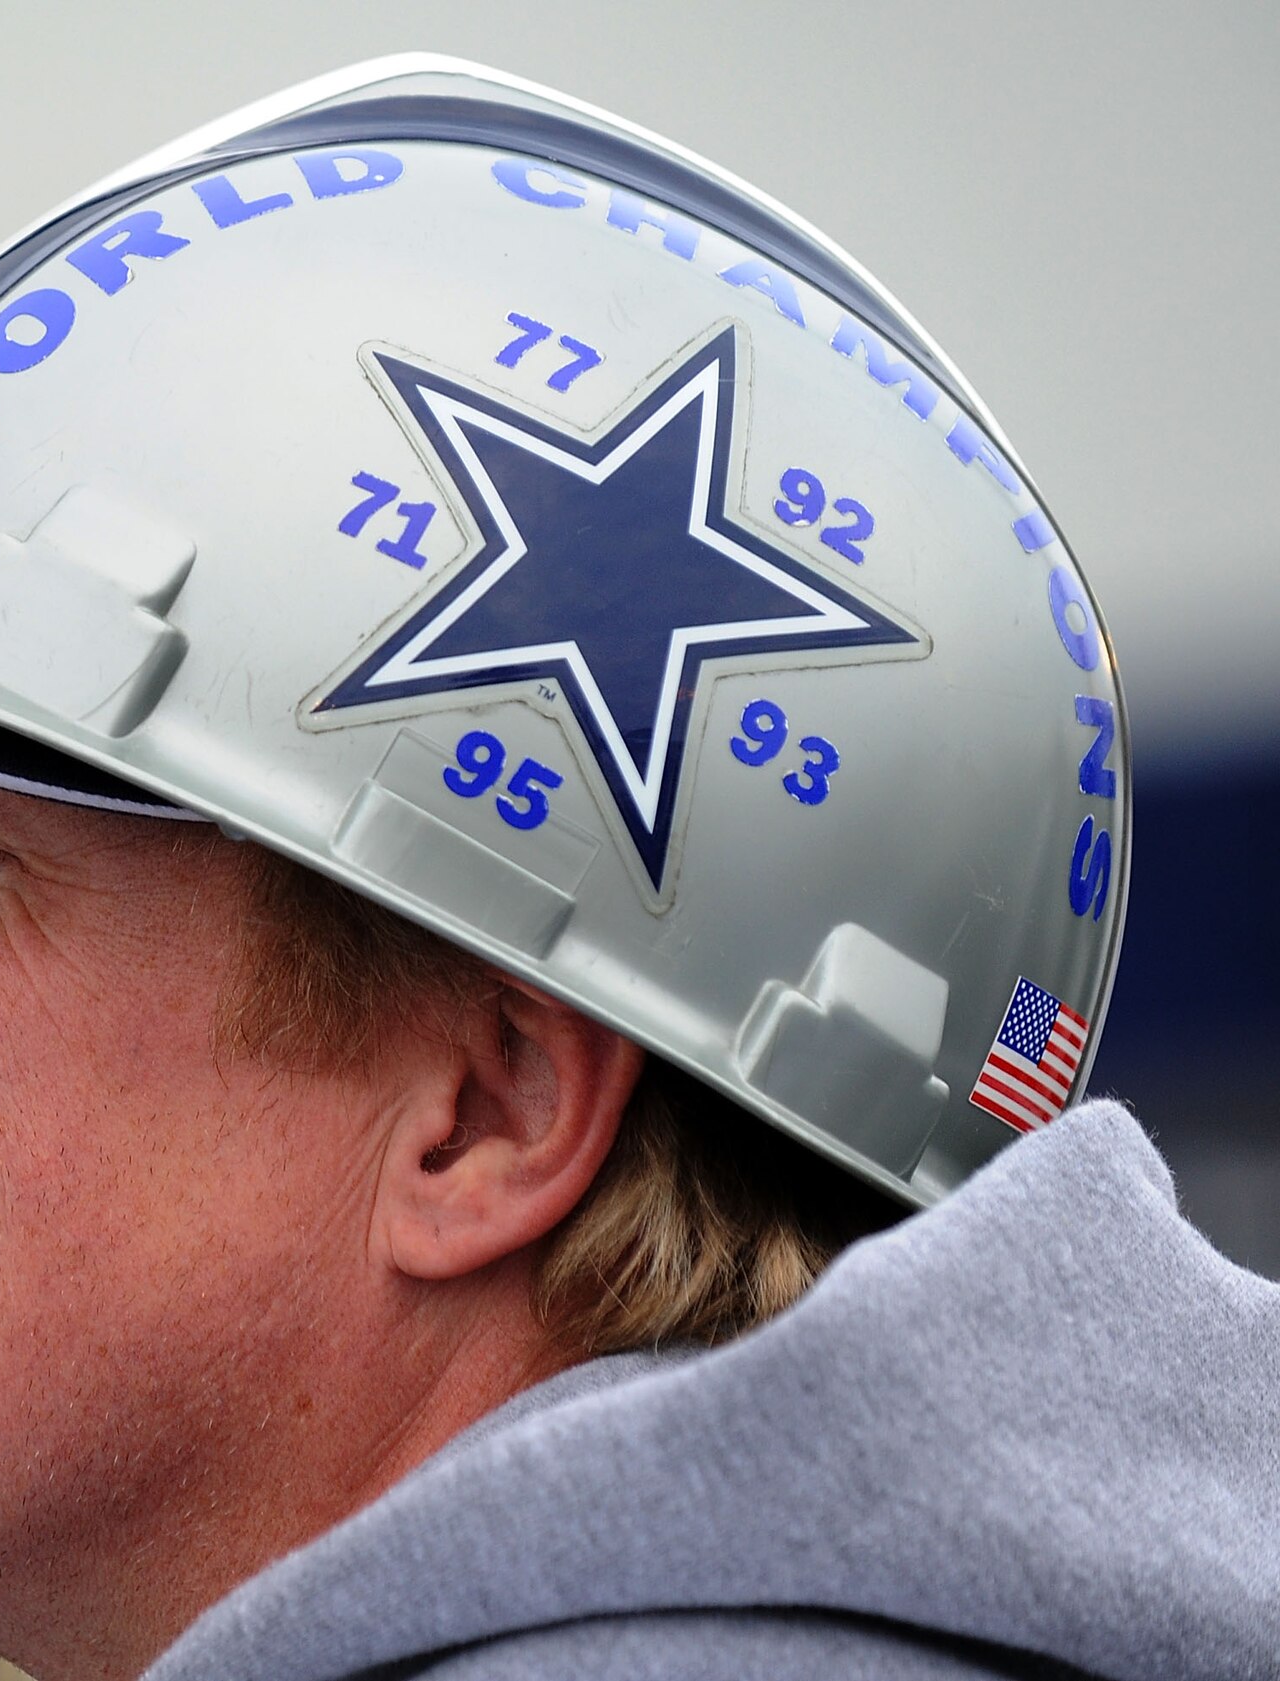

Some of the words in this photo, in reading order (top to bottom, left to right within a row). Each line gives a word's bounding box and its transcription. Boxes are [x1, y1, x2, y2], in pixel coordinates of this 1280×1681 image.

[494, 310, 605, 393] 77
[337, 470, 438, 571] 71
[490, 158, 1117, 922] CHAMPIONS
[773, 466, 875, 567] 92
[441, 729, 565, 832] 95
[728, 697, 841, 807] 93
